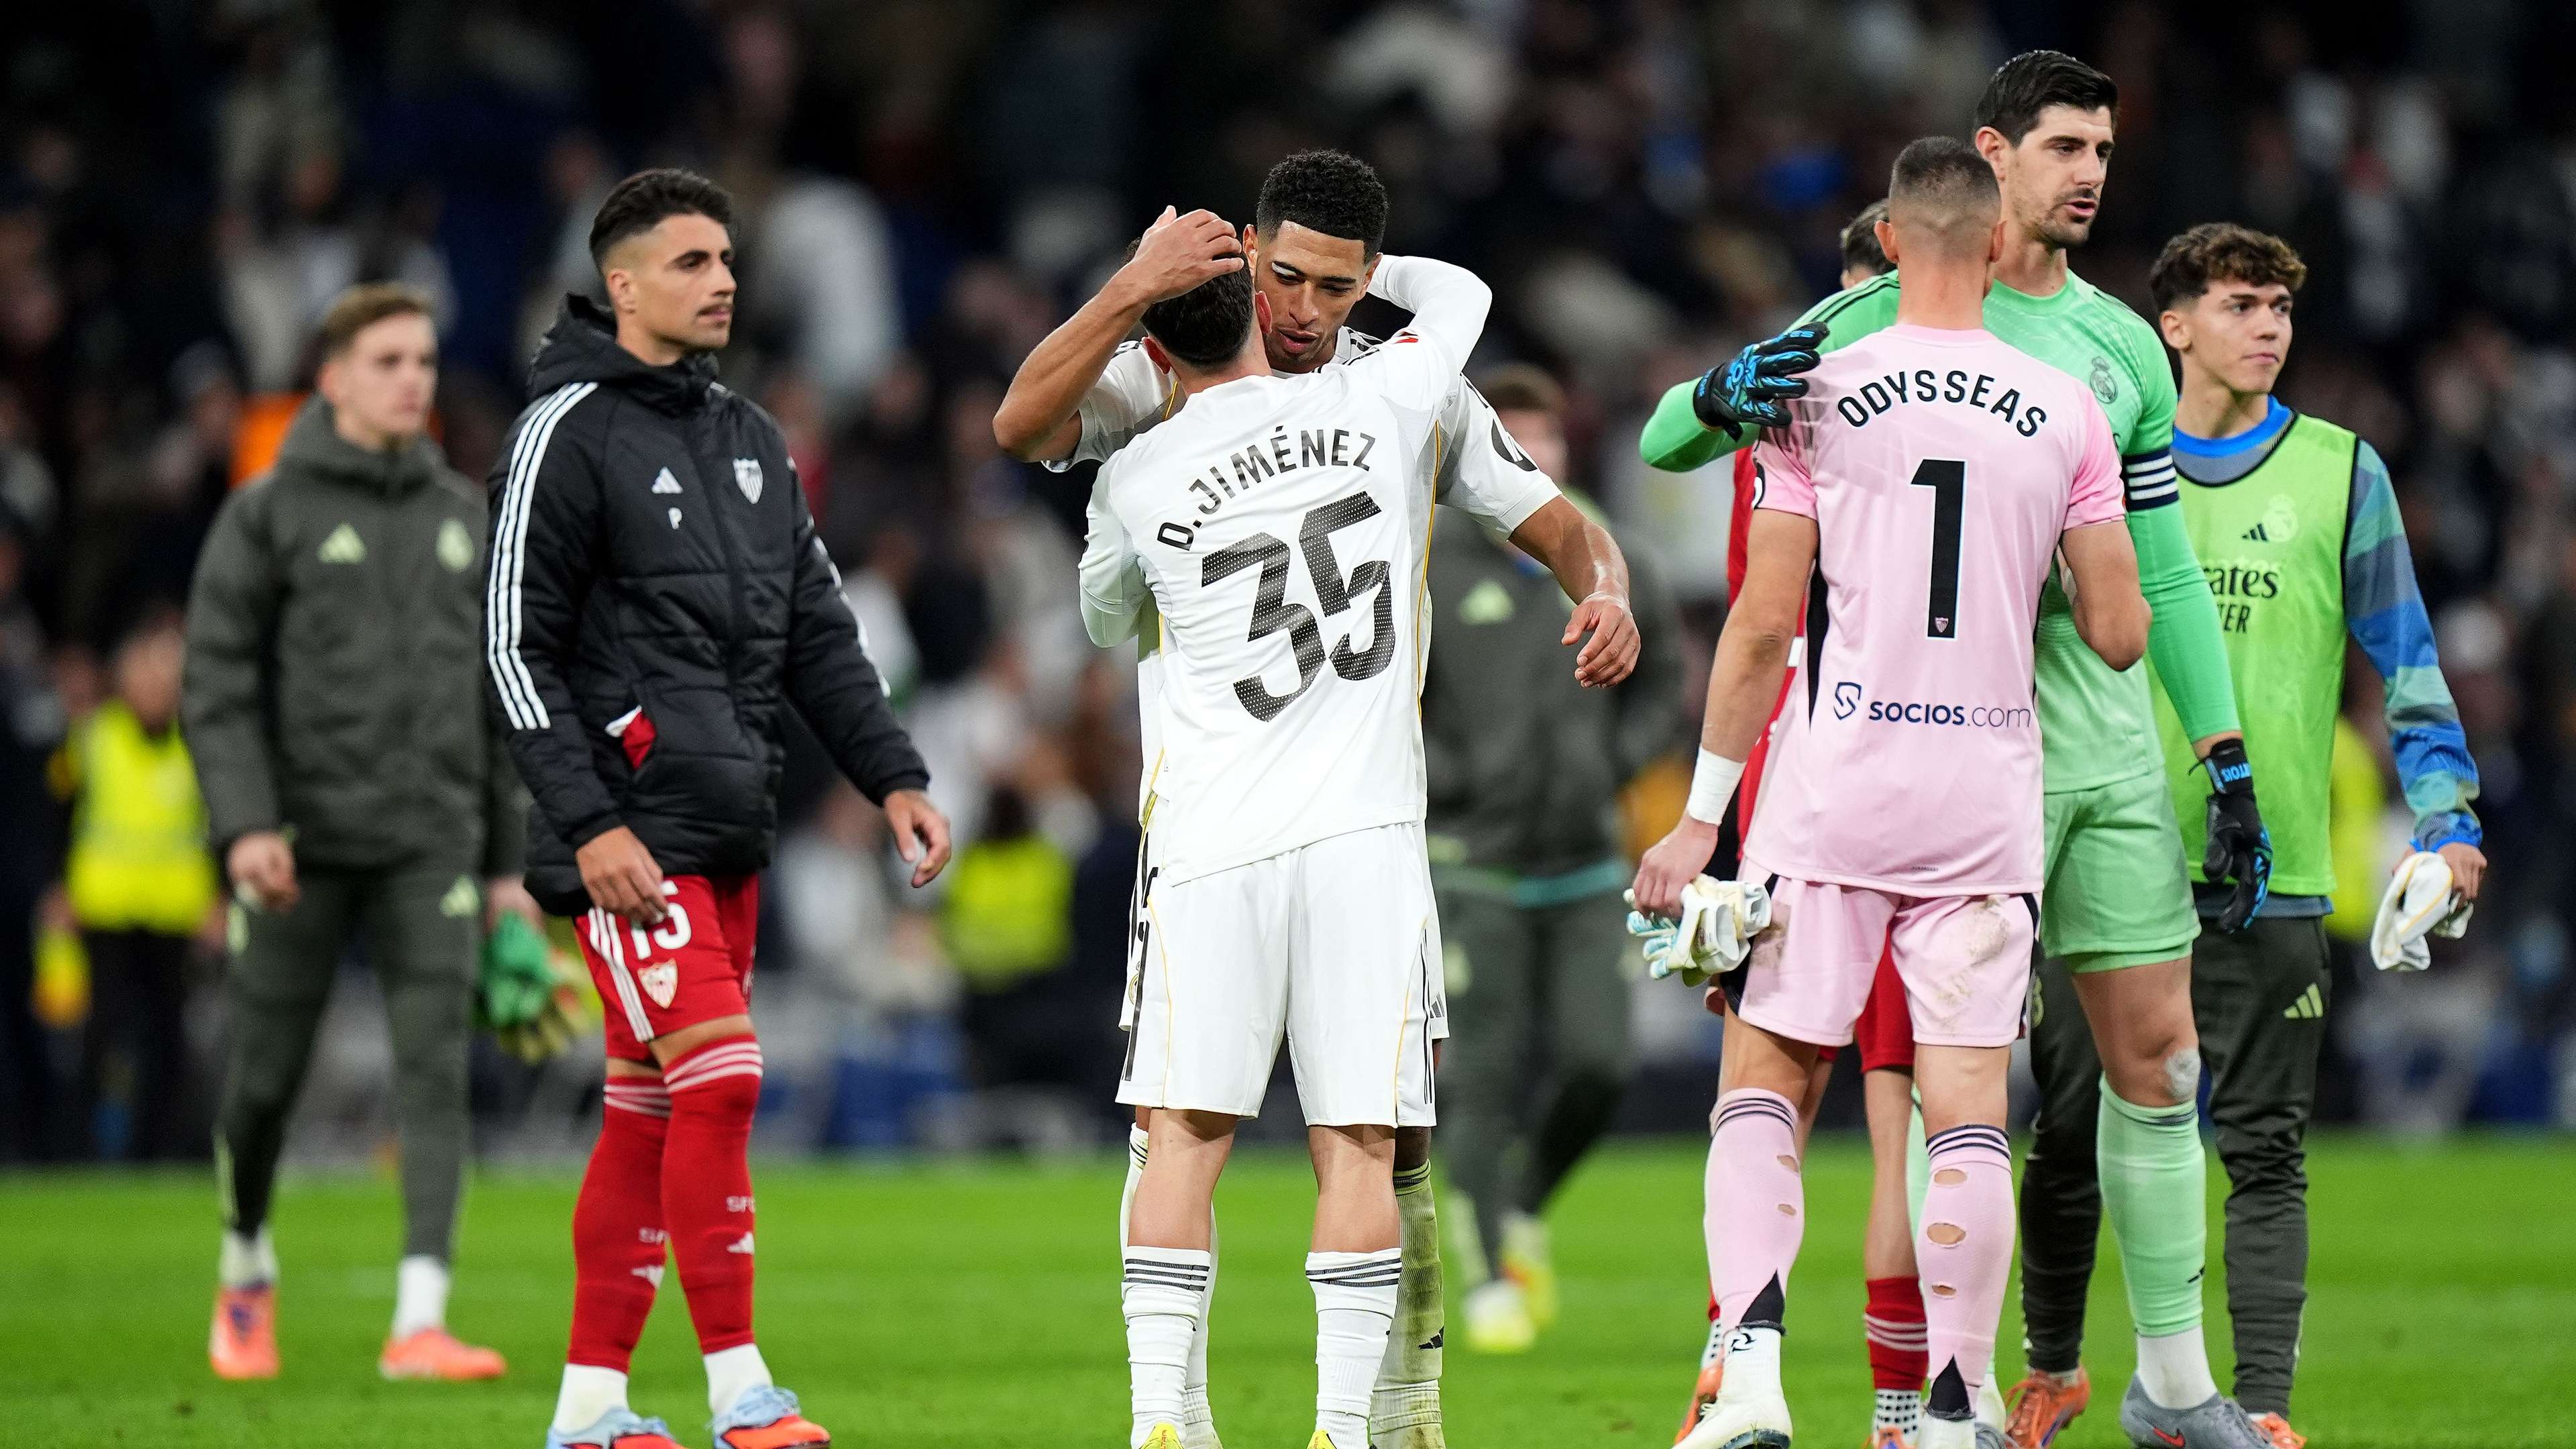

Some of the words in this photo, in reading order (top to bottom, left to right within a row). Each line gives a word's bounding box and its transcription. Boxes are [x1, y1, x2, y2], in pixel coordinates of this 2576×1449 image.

[1837, 369, 2047, 437] ODYSSEAS
[668, 507, 682, 530] P
[1157, 425, 1376, 551] D.JIMÉNEZ
[1910, 458, 1967, 639] 1
[2203, 564, 2279, 598] ates
[1201, 490, 1396, 722] 35
[1868, 701, 2031, 728] SOCIOS.com
